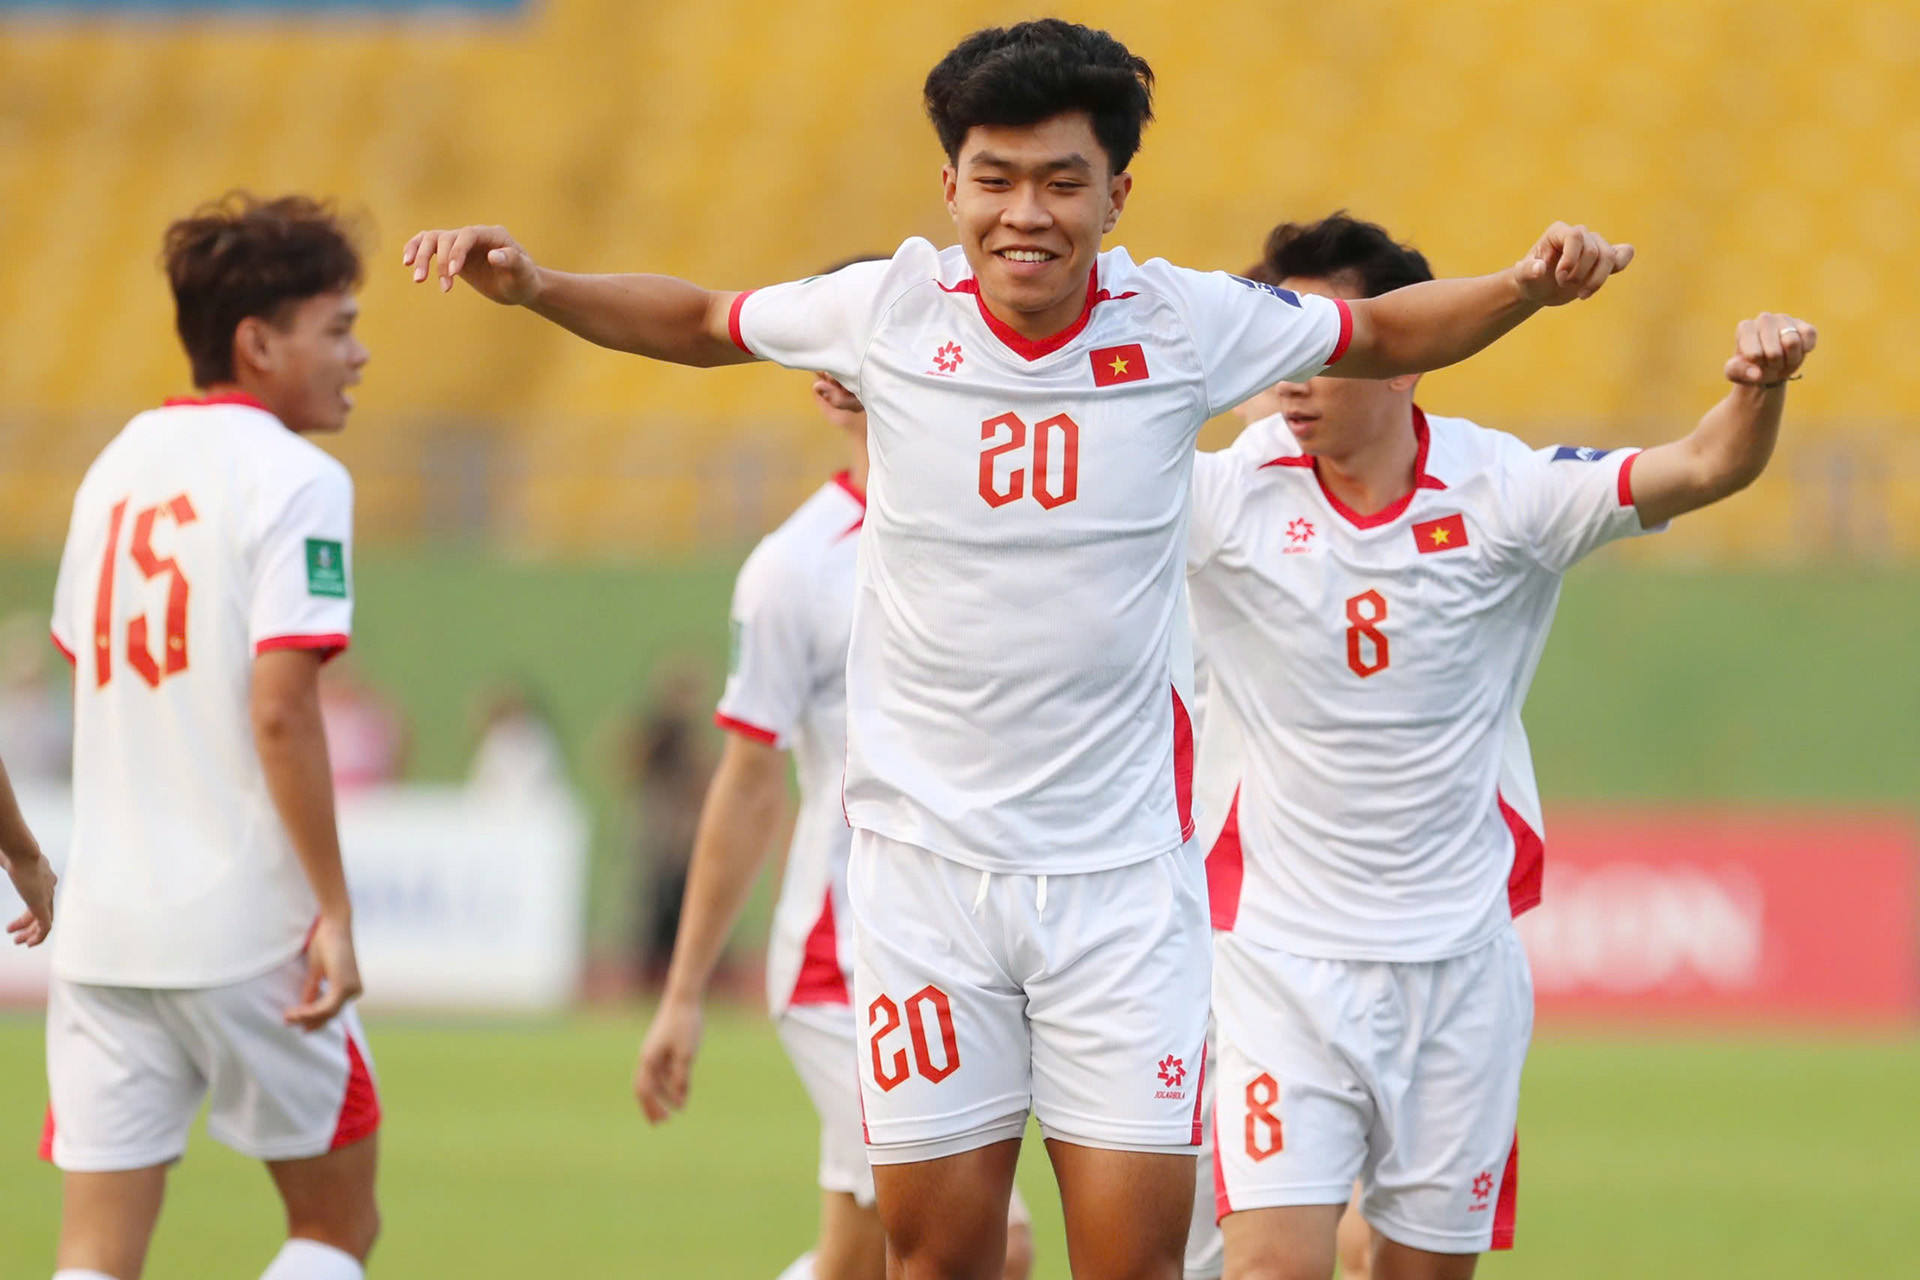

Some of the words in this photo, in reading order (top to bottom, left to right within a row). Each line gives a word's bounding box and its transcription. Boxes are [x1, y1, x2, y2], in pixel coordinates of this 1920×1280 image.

[978, 411, 1079, 511] 20
[94, 494, 197, 689] 15
[1346, 589, 1390, 679] 8
[868, 984, 961, 1093] 20
[1245, 1072, 1284, 1162] 8
